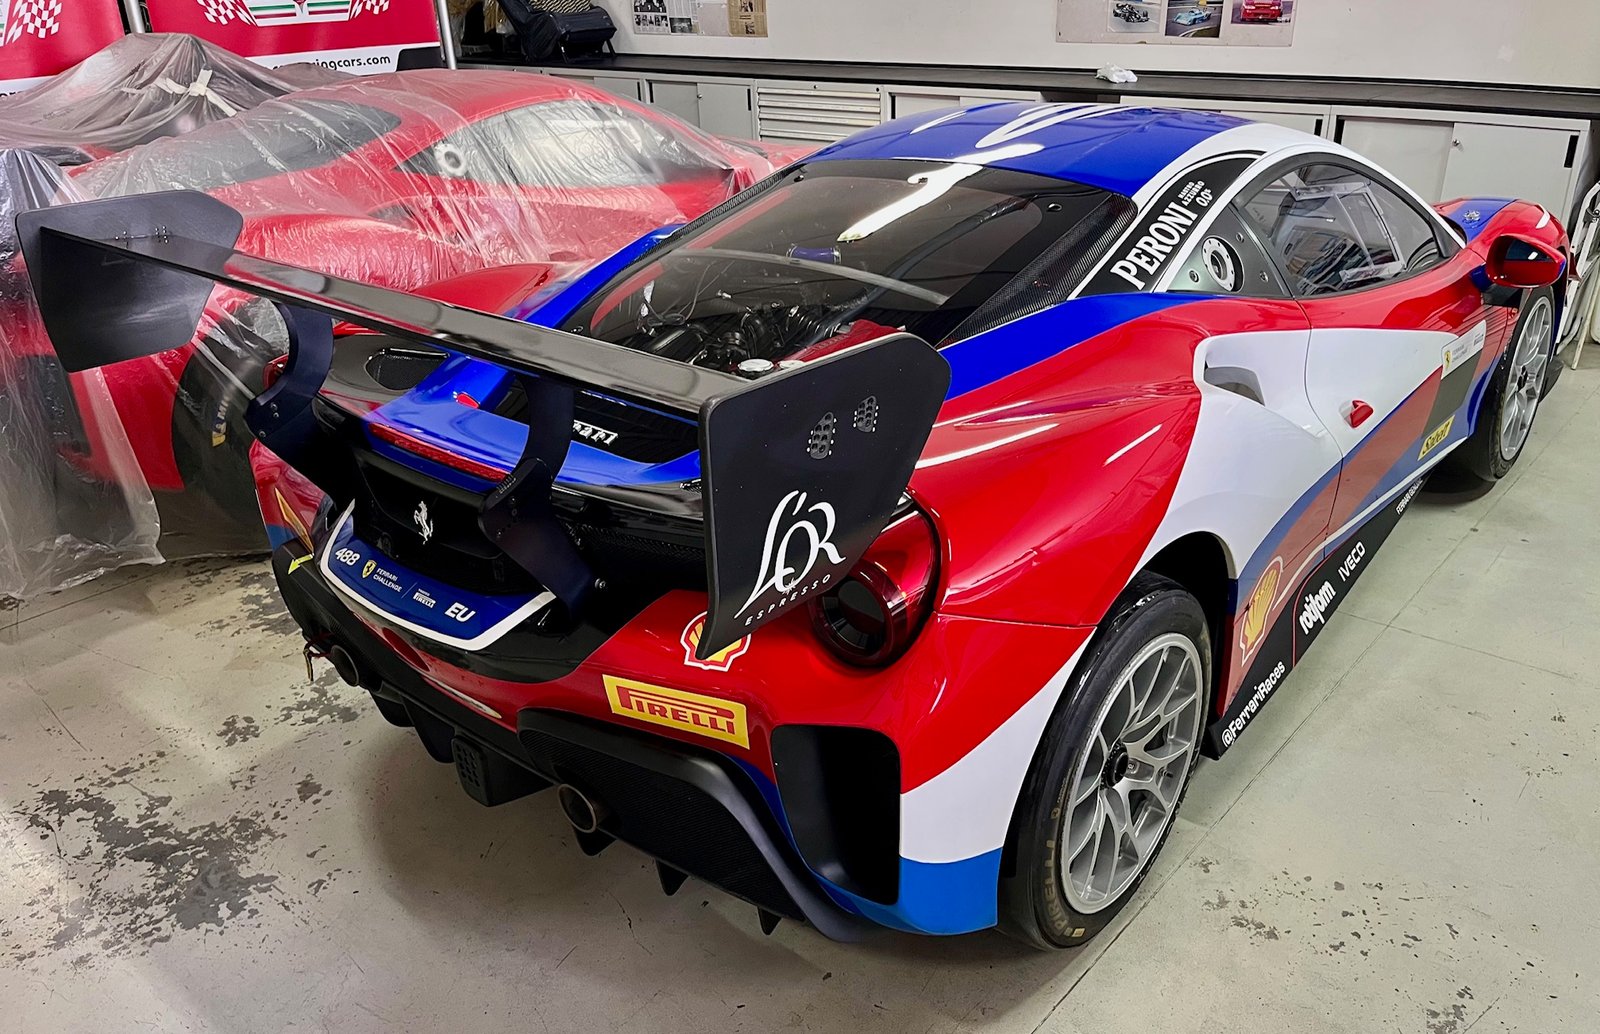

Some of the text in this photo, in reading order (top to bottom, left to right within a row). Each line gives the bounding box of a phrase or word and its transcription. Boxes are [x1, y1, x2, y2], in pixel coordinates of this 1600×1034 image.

[1181, 180, 1205, 206] AZZURRO
[1110, 201, 1198, 290] PERONI
[335, 547, 361, 566] 488
[376, 567, 399, 582] FERRARI
[1338, 541, 1365, 582] IVECO
[373, 574, 403, 593] CHALLENGE
[744, 573, 831, 626] ESPRESSO
[444, 602, 476, 623] EU
[1299, 580, 1336, 635] rotiform
[615, 685, 736, 735] PIRELLI
[1221, 661, 1286, 748] @FerrariRaces
